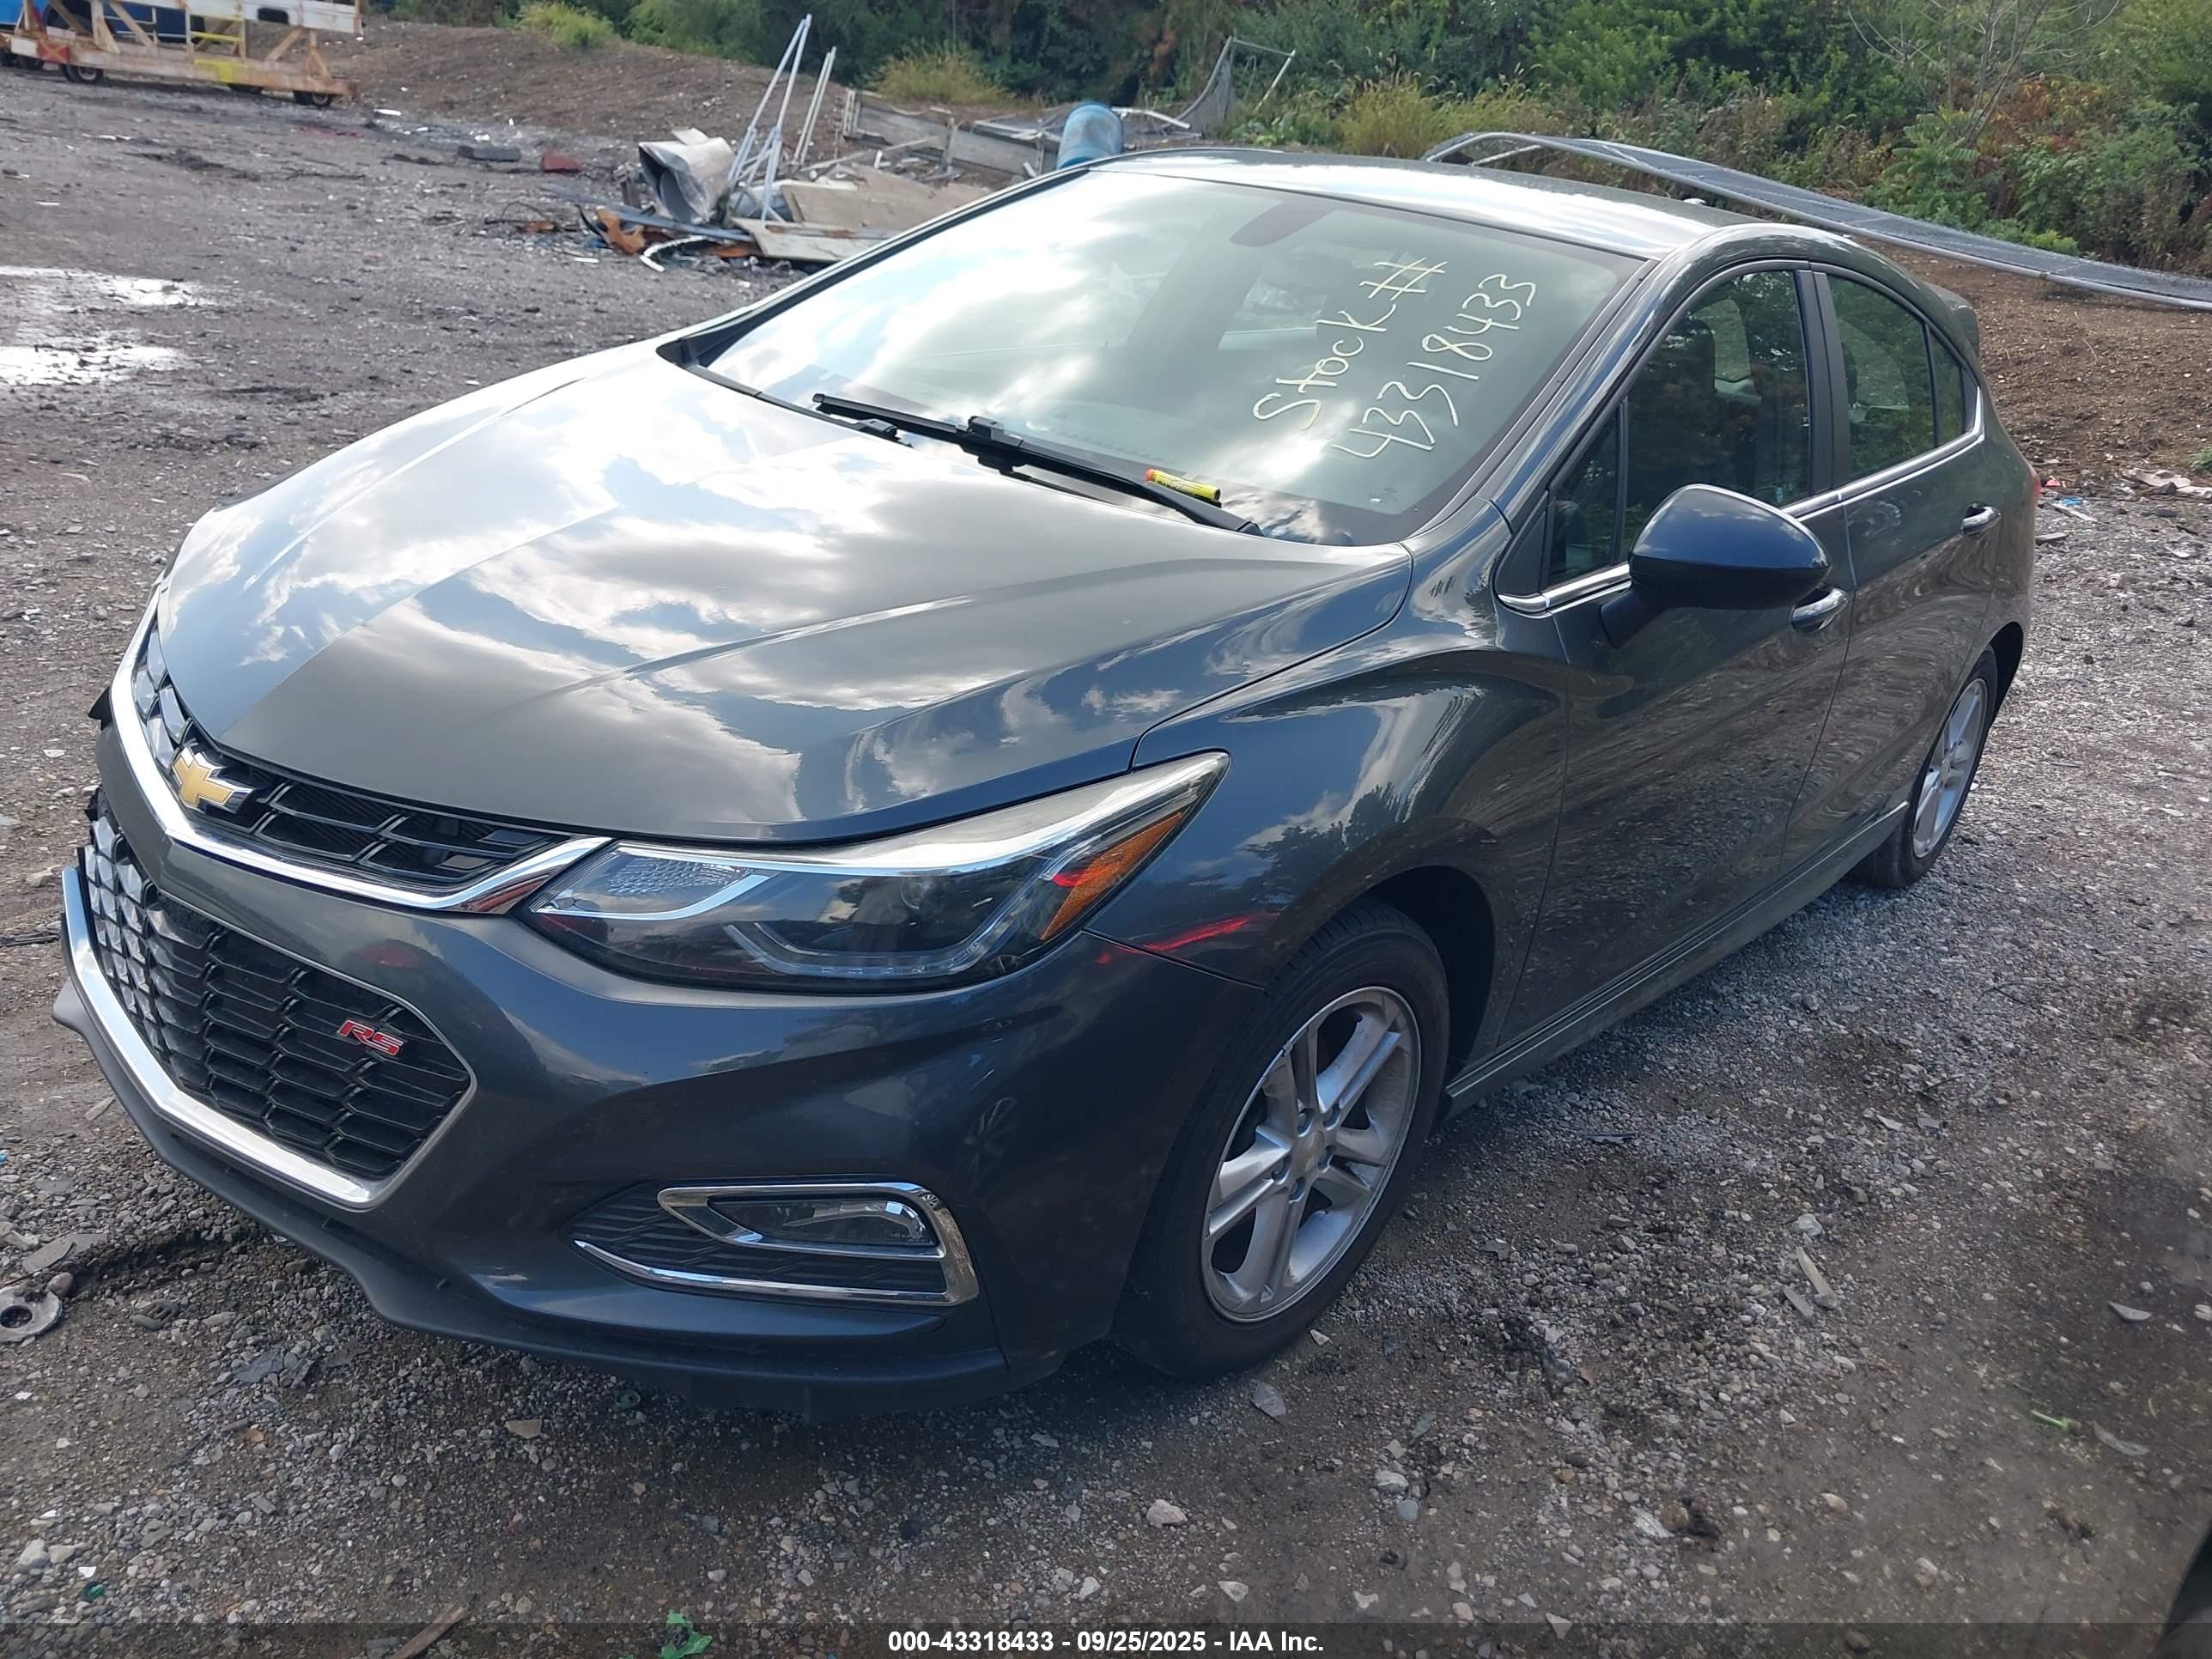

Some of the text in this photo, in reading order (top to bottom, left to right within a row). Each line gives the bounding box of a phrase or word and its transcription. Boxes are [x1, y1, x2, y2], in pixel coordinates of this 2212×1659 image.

[1253, 256, 1449, 431] Stock #
[1332, 273, 1537, 459] 43318433
[336, 1019, 405, 1056] RS
